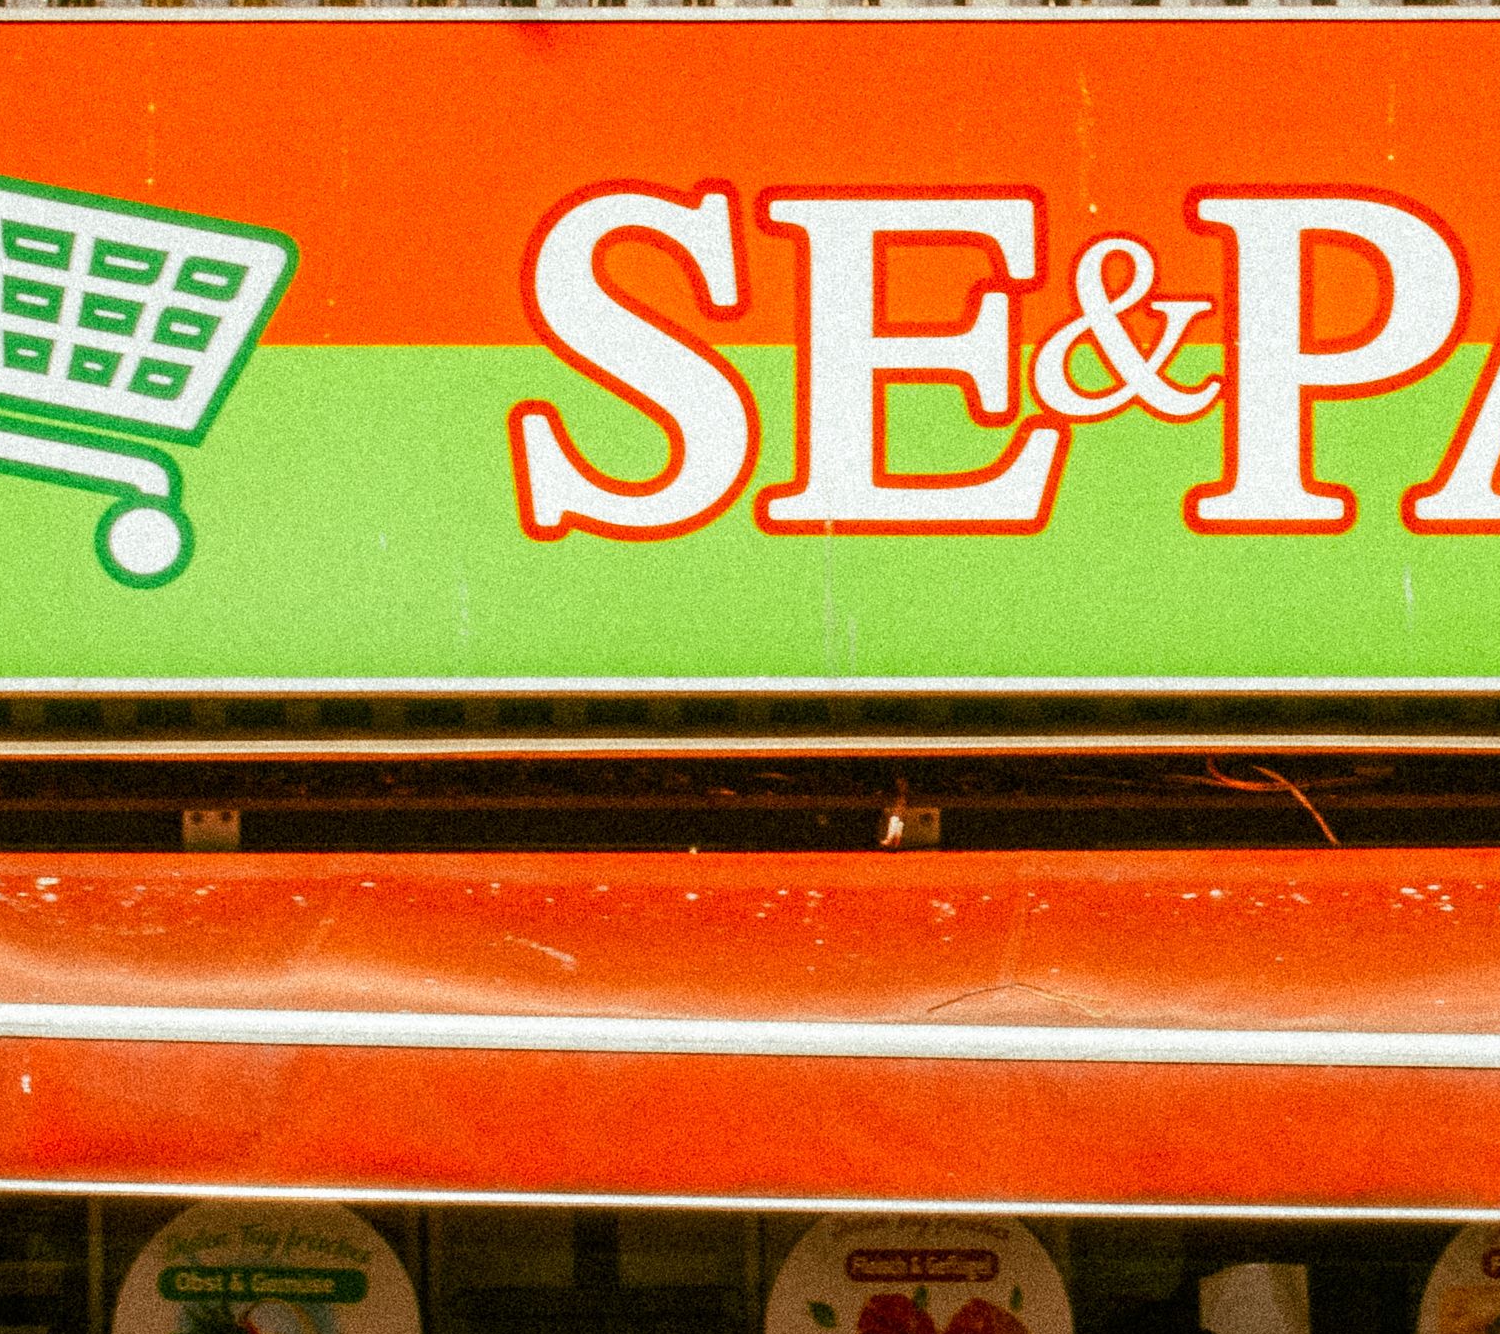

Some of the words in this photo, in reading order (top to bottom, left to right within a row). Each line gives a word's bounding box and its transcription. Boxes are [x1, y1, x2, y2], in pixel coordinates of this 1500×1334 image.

[173, 1270, 224, 1294] Obst
[228, 1271, 246, 1294] &
[250, 1271, 336, 1295] Gemüse
